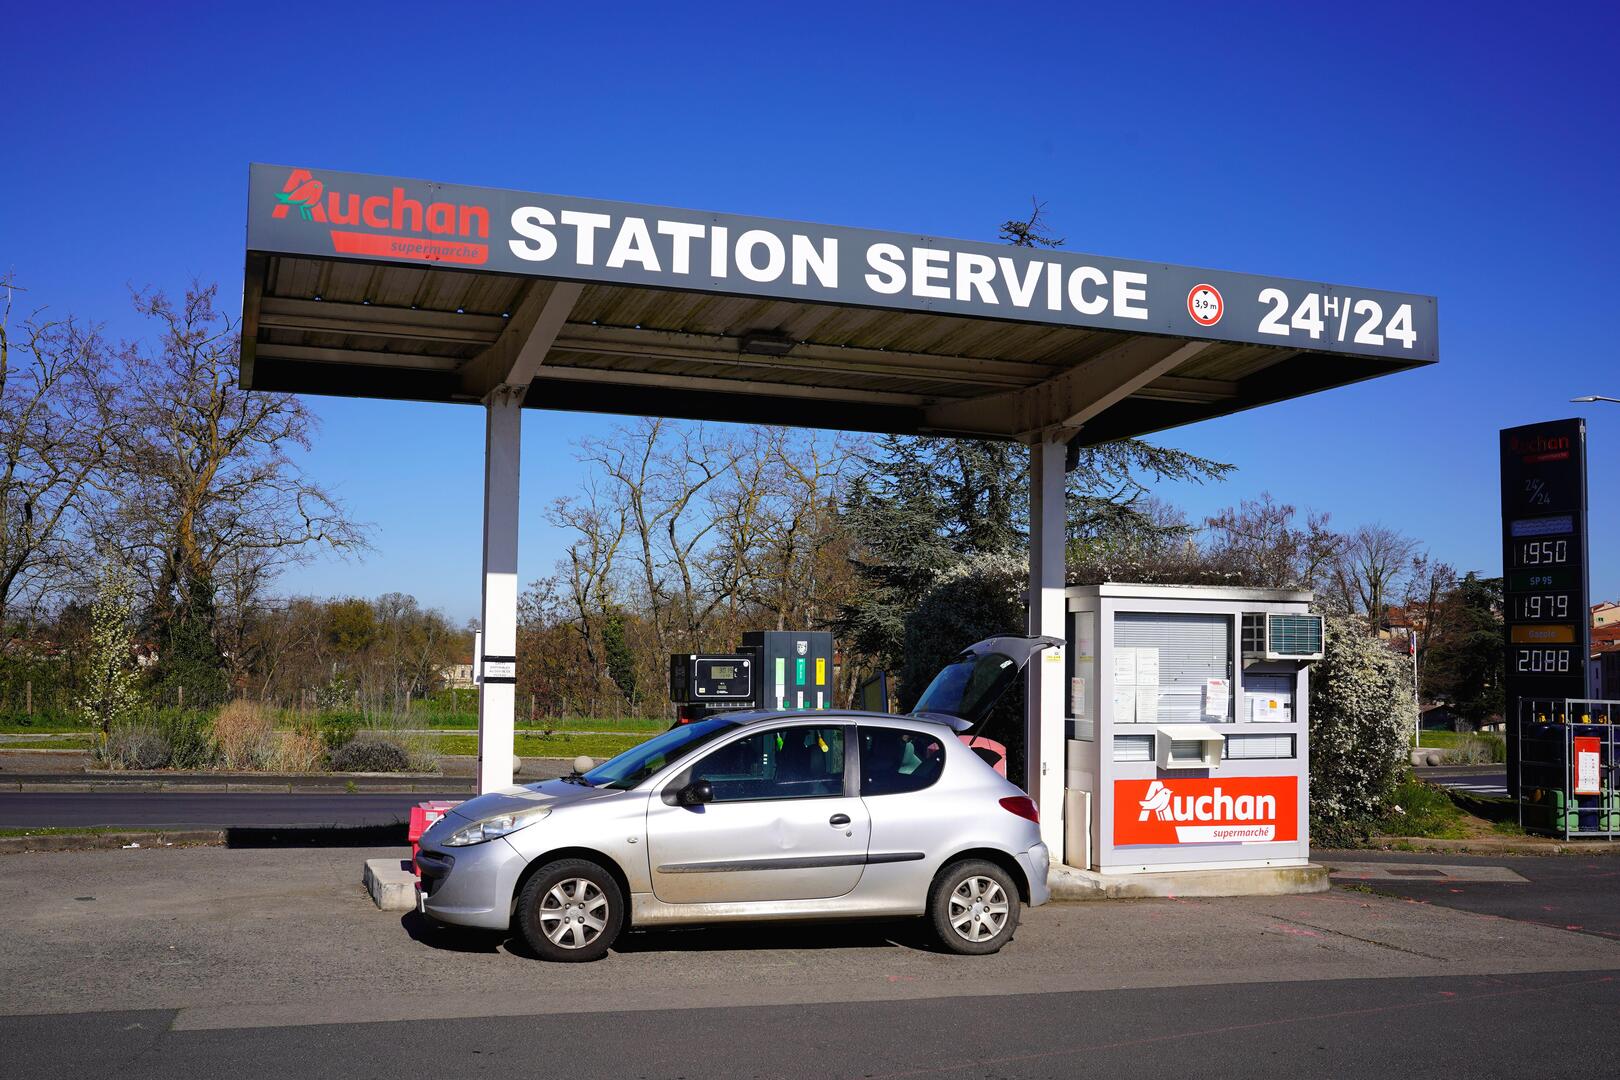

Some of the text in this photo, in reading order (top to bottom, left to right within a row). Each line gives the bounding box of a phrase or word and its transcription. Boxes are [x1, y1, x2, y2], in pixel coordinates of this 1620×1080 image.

[272, 169, 489, 239] Auchan
[391, 242, 480, 257] supermarché
[508, 206, 1148, 320] STATION SERVICE
[1195, 299, 1208, 309] 3,9
[1138, 780, 1276, 821] Auchan
[1213, 827, 1269, 839] supermarché
